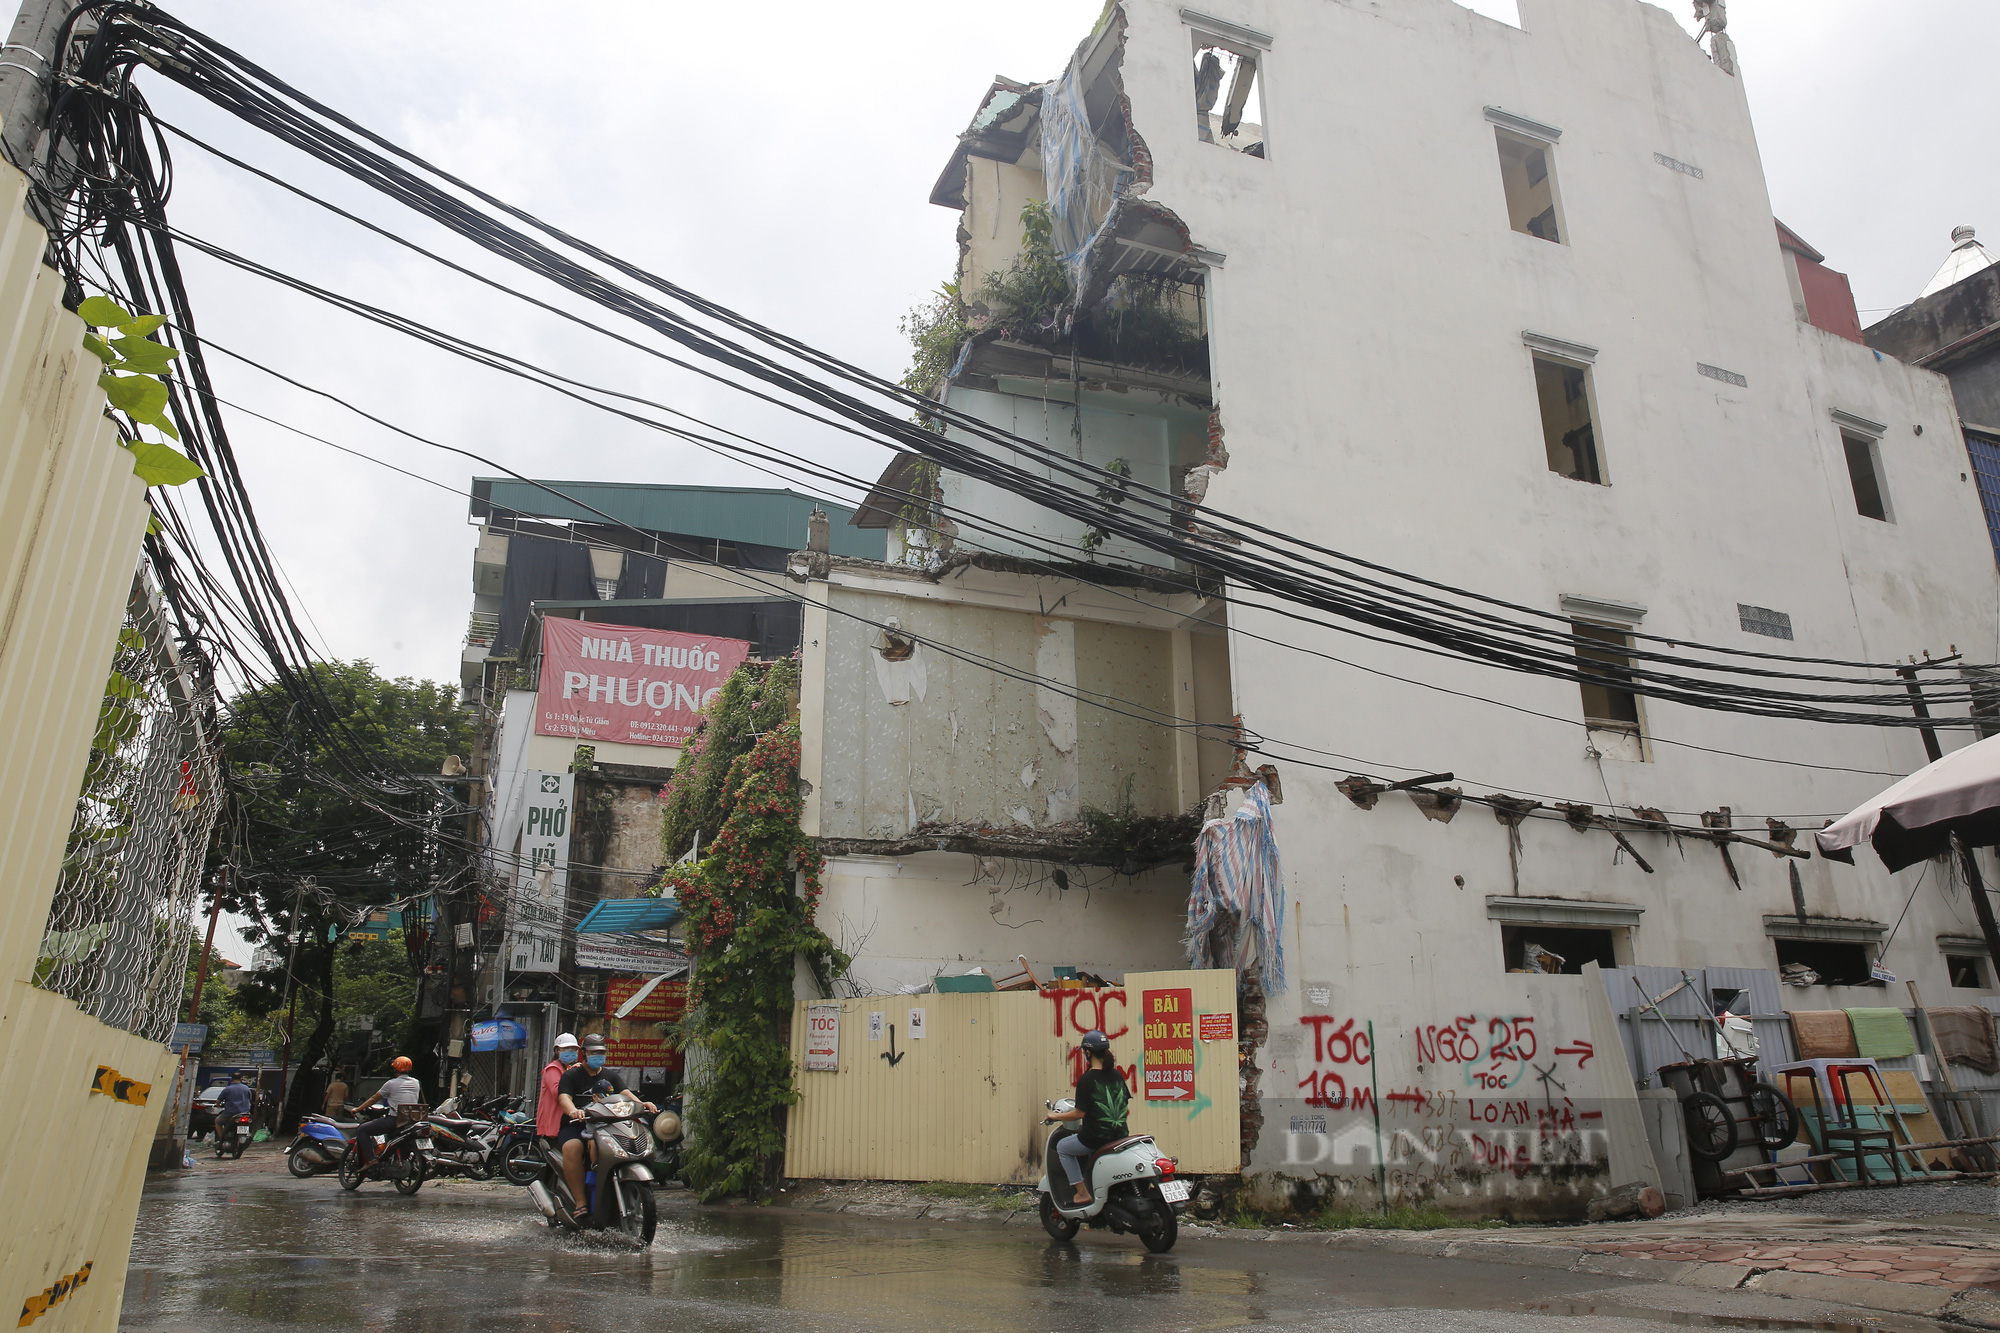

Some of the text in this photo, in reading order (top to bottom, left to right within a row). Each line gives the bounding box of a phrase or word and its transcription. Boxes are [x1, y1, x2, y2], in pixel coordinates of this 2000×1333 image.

[581, 636, 720, 673] NHÀ THUỐC
[544, 723, 552, 731] Cs
[629, 732, 651, 741] Hotline:
[640, 721, 678, 732] 0912.320.441
[527, 798, 568, 837] PHỞ
[1039, 987, 1129, 1040] TÓC
[1153, 994, 1179, 1014] BÃI
[811, 1015, 835, 1031] TÓC
[1144, 1018, 1168, 1040] GỬI
[1172, 1022, 1192, 1039] XE
[627, 1043, 639, 1051] Luật
[1299, 1014, 1371, 1066] TÓC
[1415, 1014, 1537, 1064] NGÕ 25
[1145, 1045, 1193, 1066] CÔNG TRƯỜNG
[1146, 1070, 1193, 1083] 0923 23 23 66
[1472, 1061, 1508, 1090] TÓC
[1468, 1098, 1531, 1125] LOAN
[1165, 1190, 1188, 1202] 626.95
